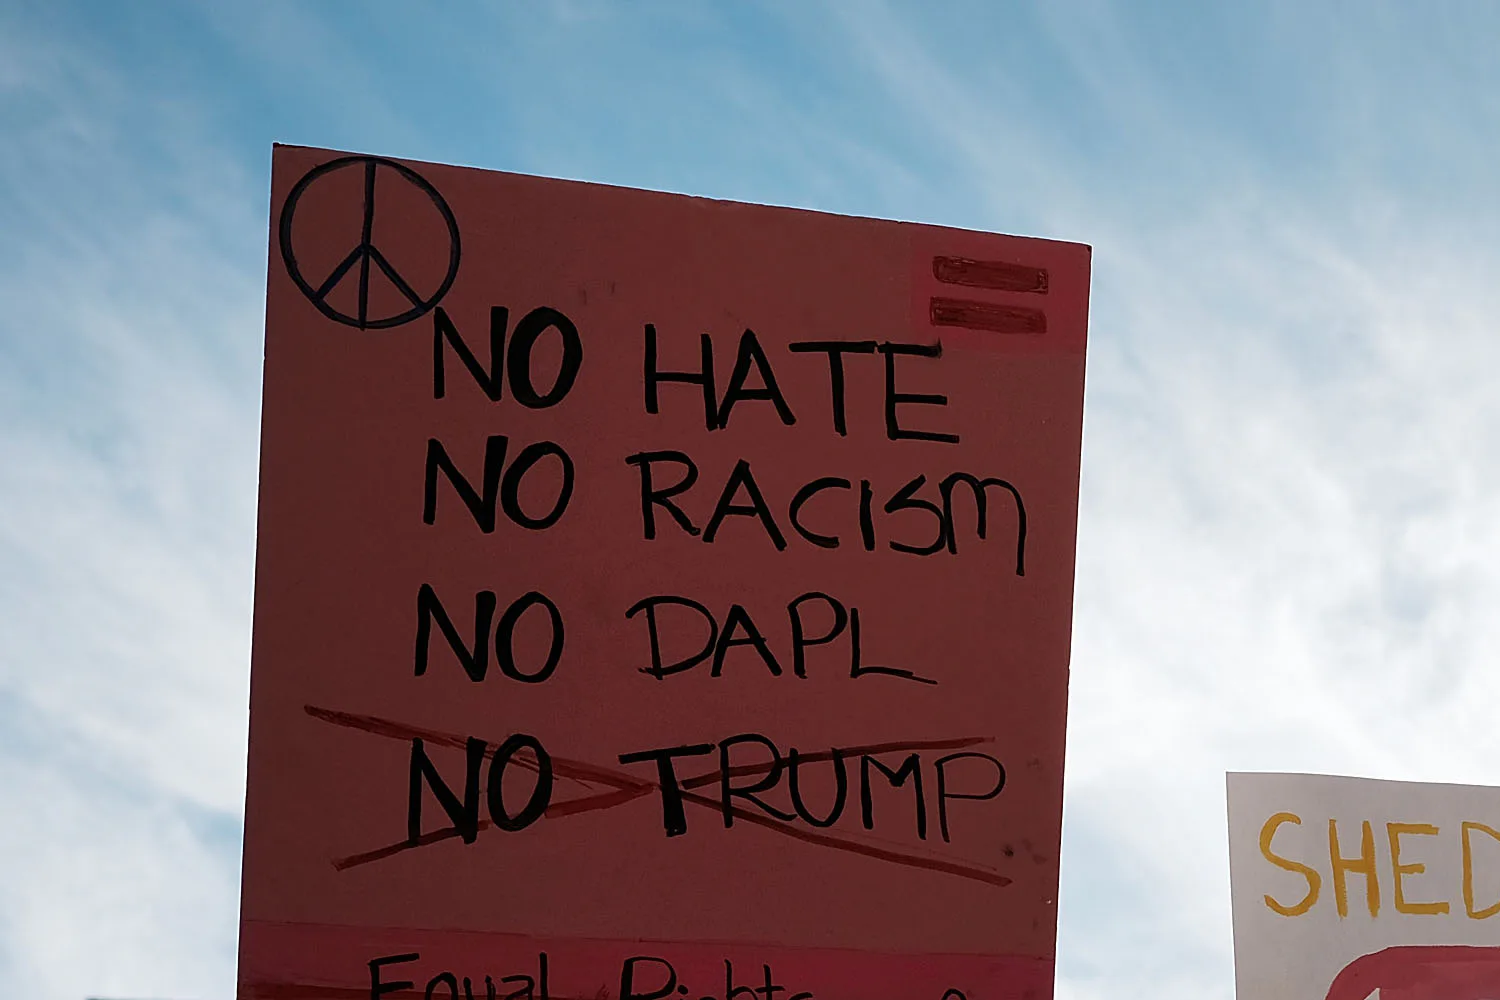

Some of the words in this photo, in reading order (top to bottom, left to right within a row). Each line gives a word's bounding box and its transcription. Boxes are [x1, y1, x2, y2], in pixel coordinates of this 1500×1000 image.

[434, 306, 583, 409] NO
[644, 324, 960, 443] HATE
[423, 435, 575, 534] NO
[414, 583, 565, 684] NO
[625, 592, 938, 685] DAPL
[407, 733, 555, 846] NO
[619, 734, 1006, 844] TRUMP
